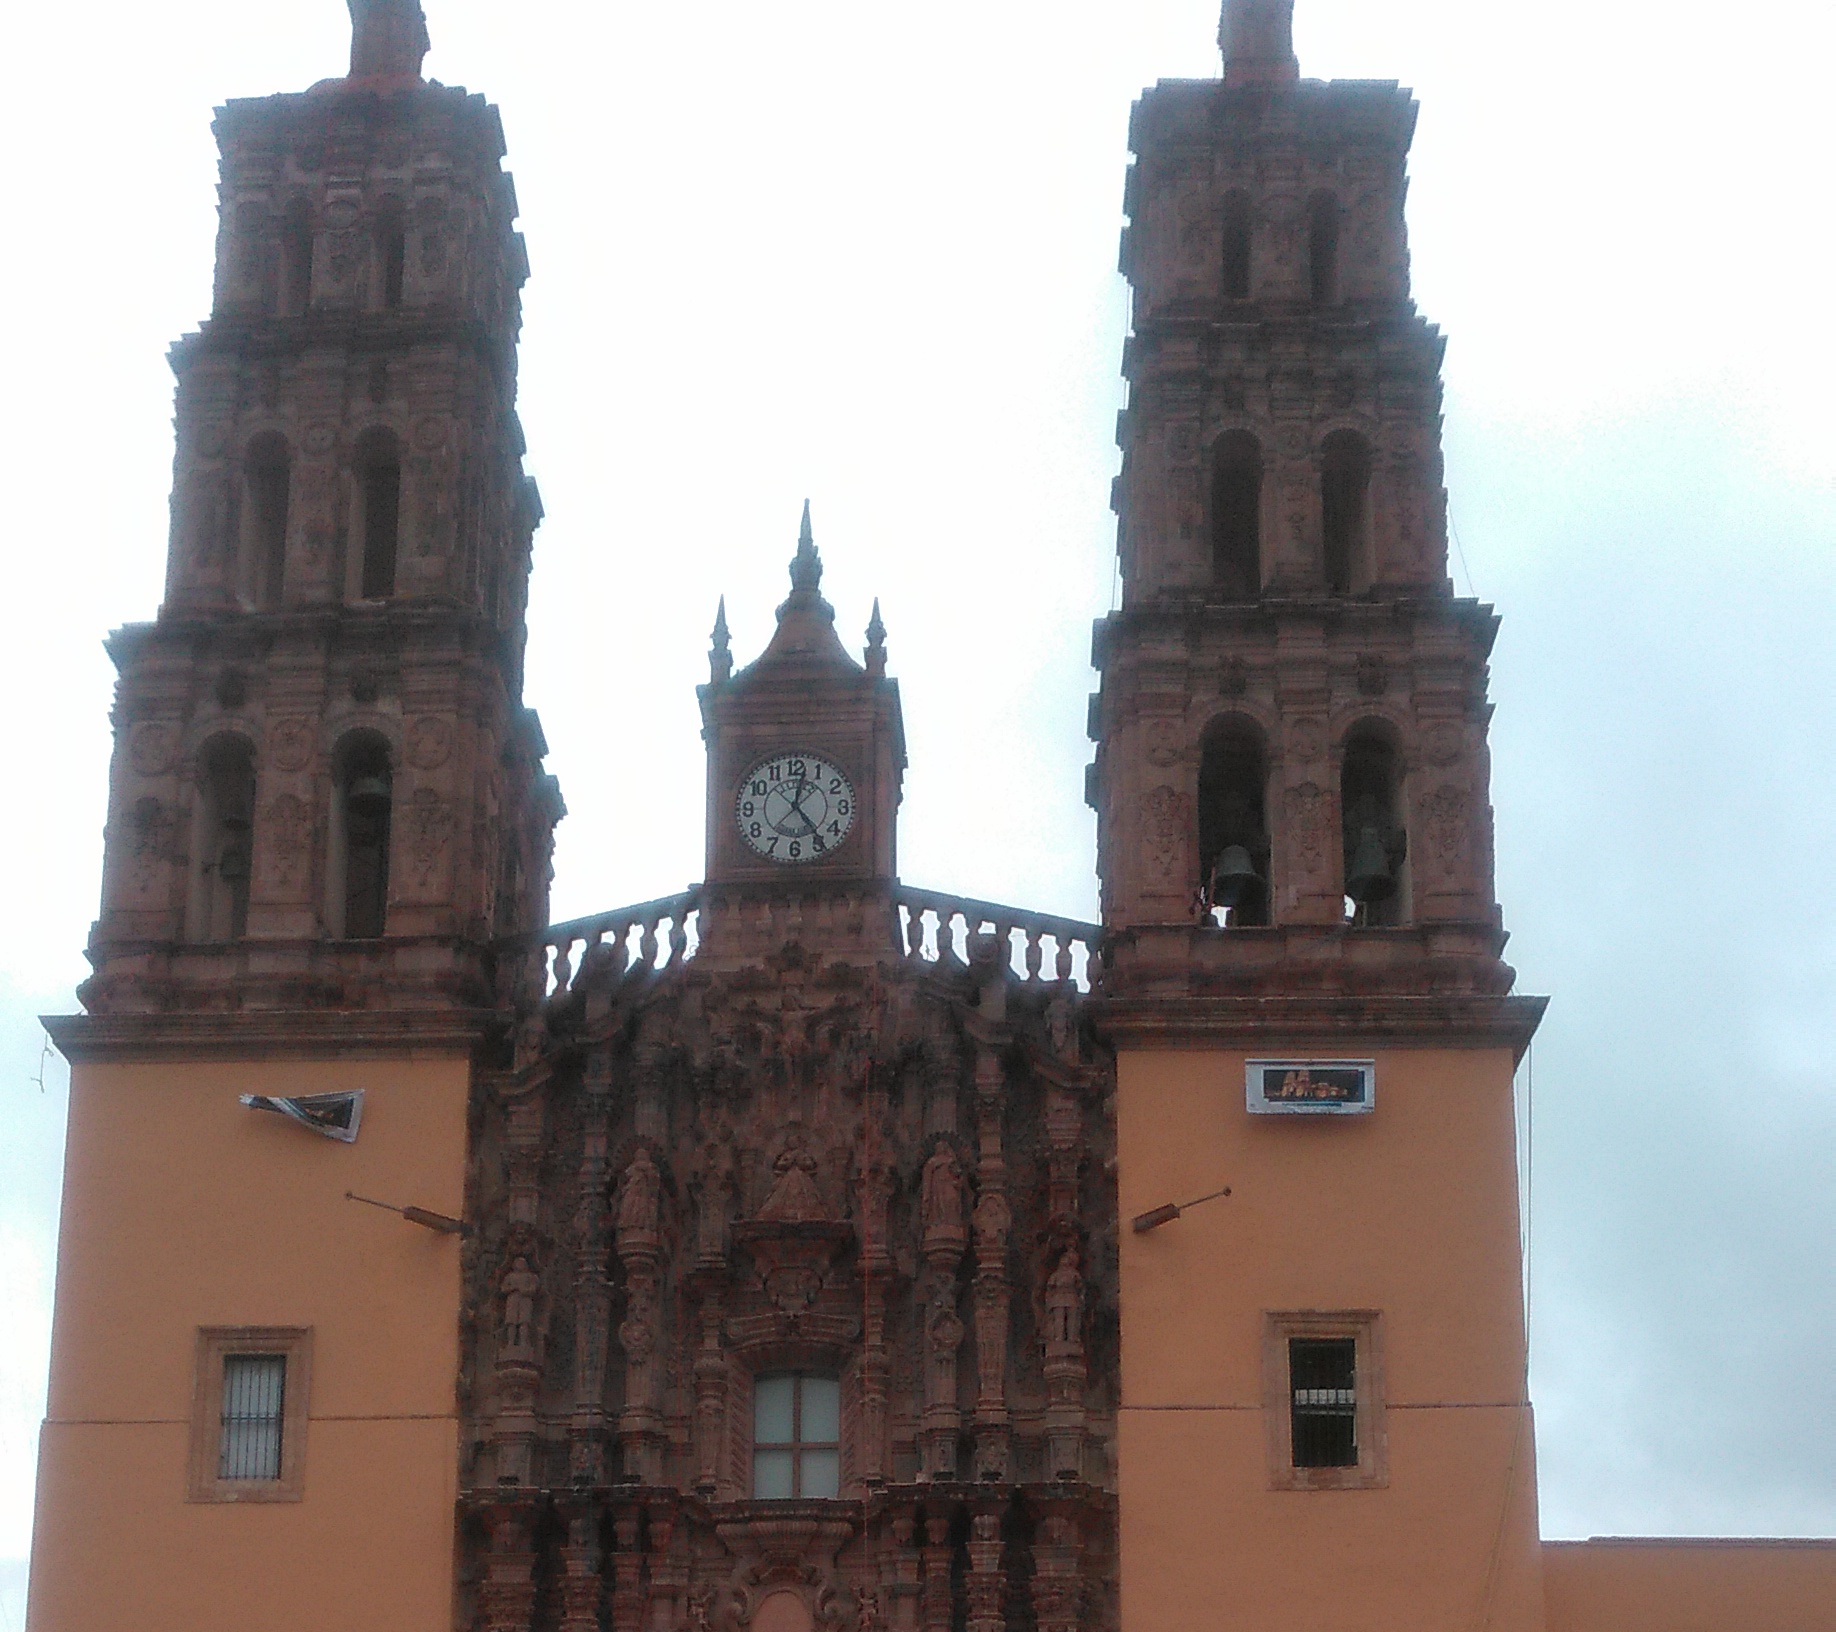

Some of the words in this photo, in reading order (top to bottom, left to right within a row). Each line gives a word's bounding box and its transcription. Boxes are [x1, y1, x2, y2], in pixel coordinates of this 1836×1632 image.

[769, 764, 780, 781] 11
[787, 760, 806, 776] 12
[814, 763, 821, 780] 1
[750, 780, 768, 796] 10
[829, 779, 842, 795] 2
[742, 801, 754, 818] 9
[838, 799, 850, 816] 3
[750, 822, 762, 838] 8
[827, 820, 841, 837] 4
[766, 837, 779, 855] 7
[789, 841, 801, 858] 6
